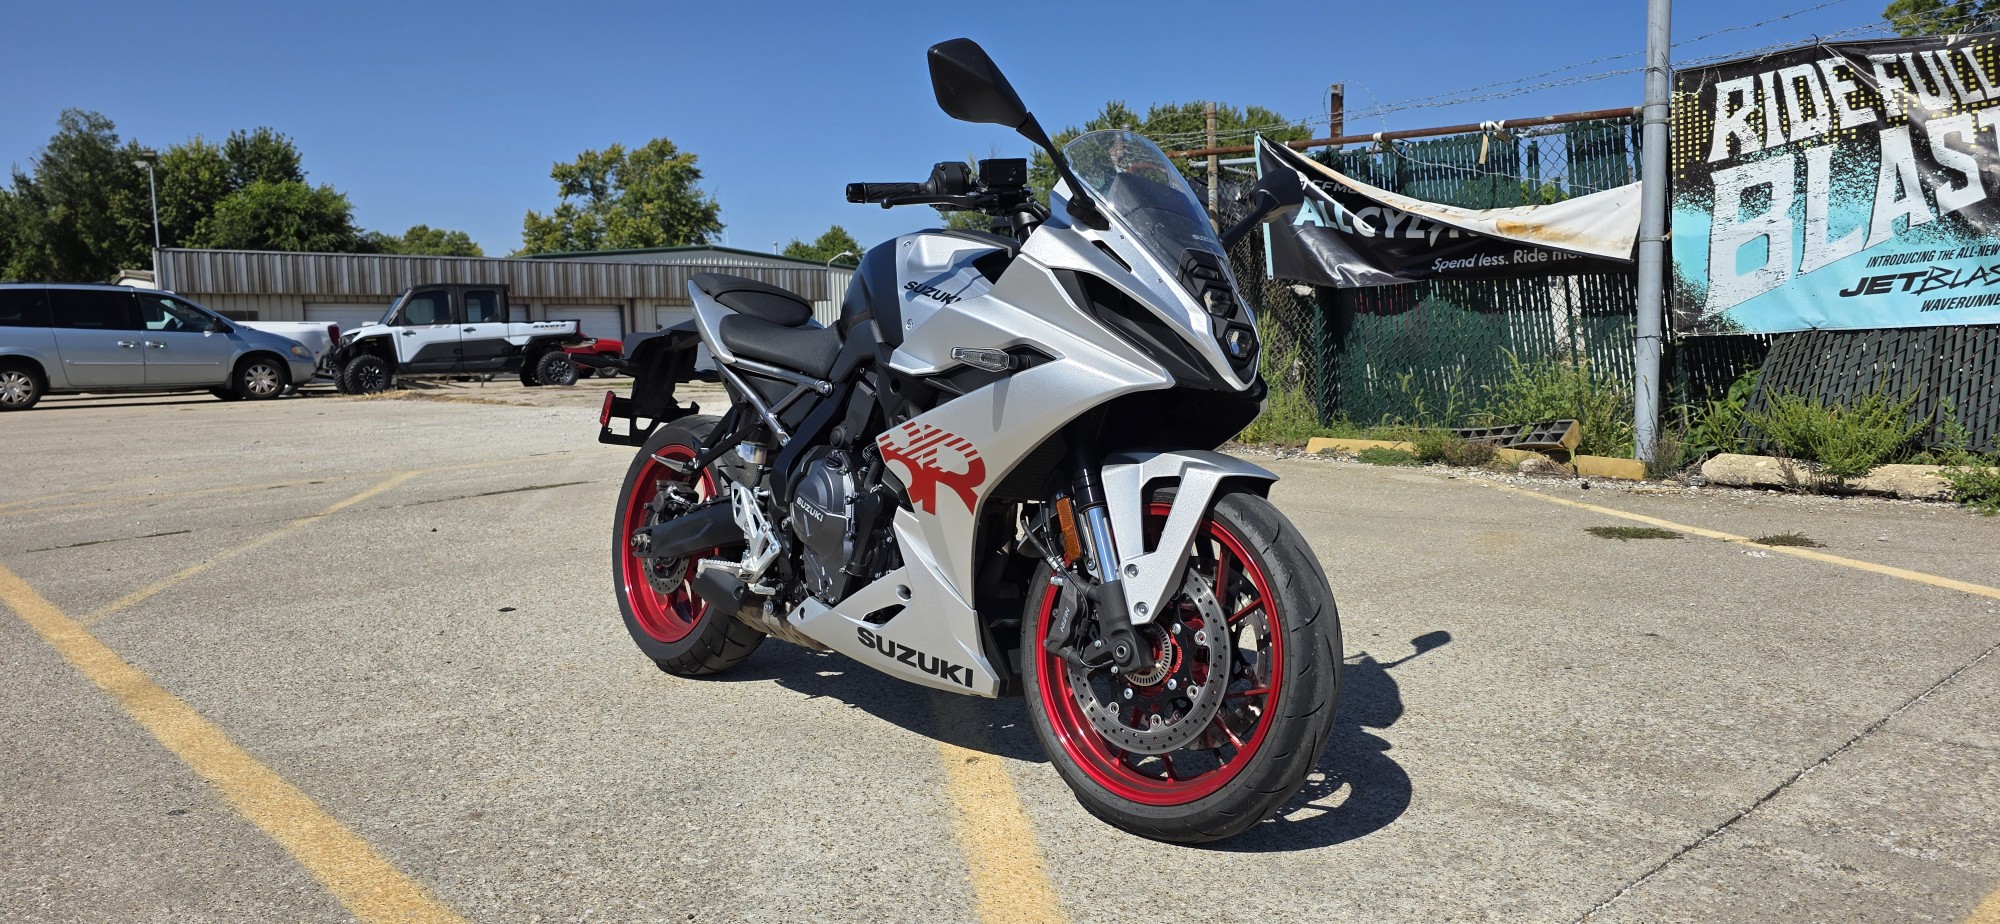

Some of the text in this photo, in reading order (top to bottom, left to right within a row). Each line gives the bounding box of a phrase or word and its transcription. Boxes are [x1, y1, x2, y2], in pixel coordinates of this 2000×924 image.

[1708, 57, 1877, 163] RIDE
[1431, 254, 1477, 272] Spend
[1478, 253, 1509, 266] less.
[1513, 248, 1548, 264] Ride
[1866, 244, 2000, 268] INTRODUCING THE ALL-NEW
[796, 496, 824, 522] SUZUKI
[857, 626, 974, 688] SUZUKI
